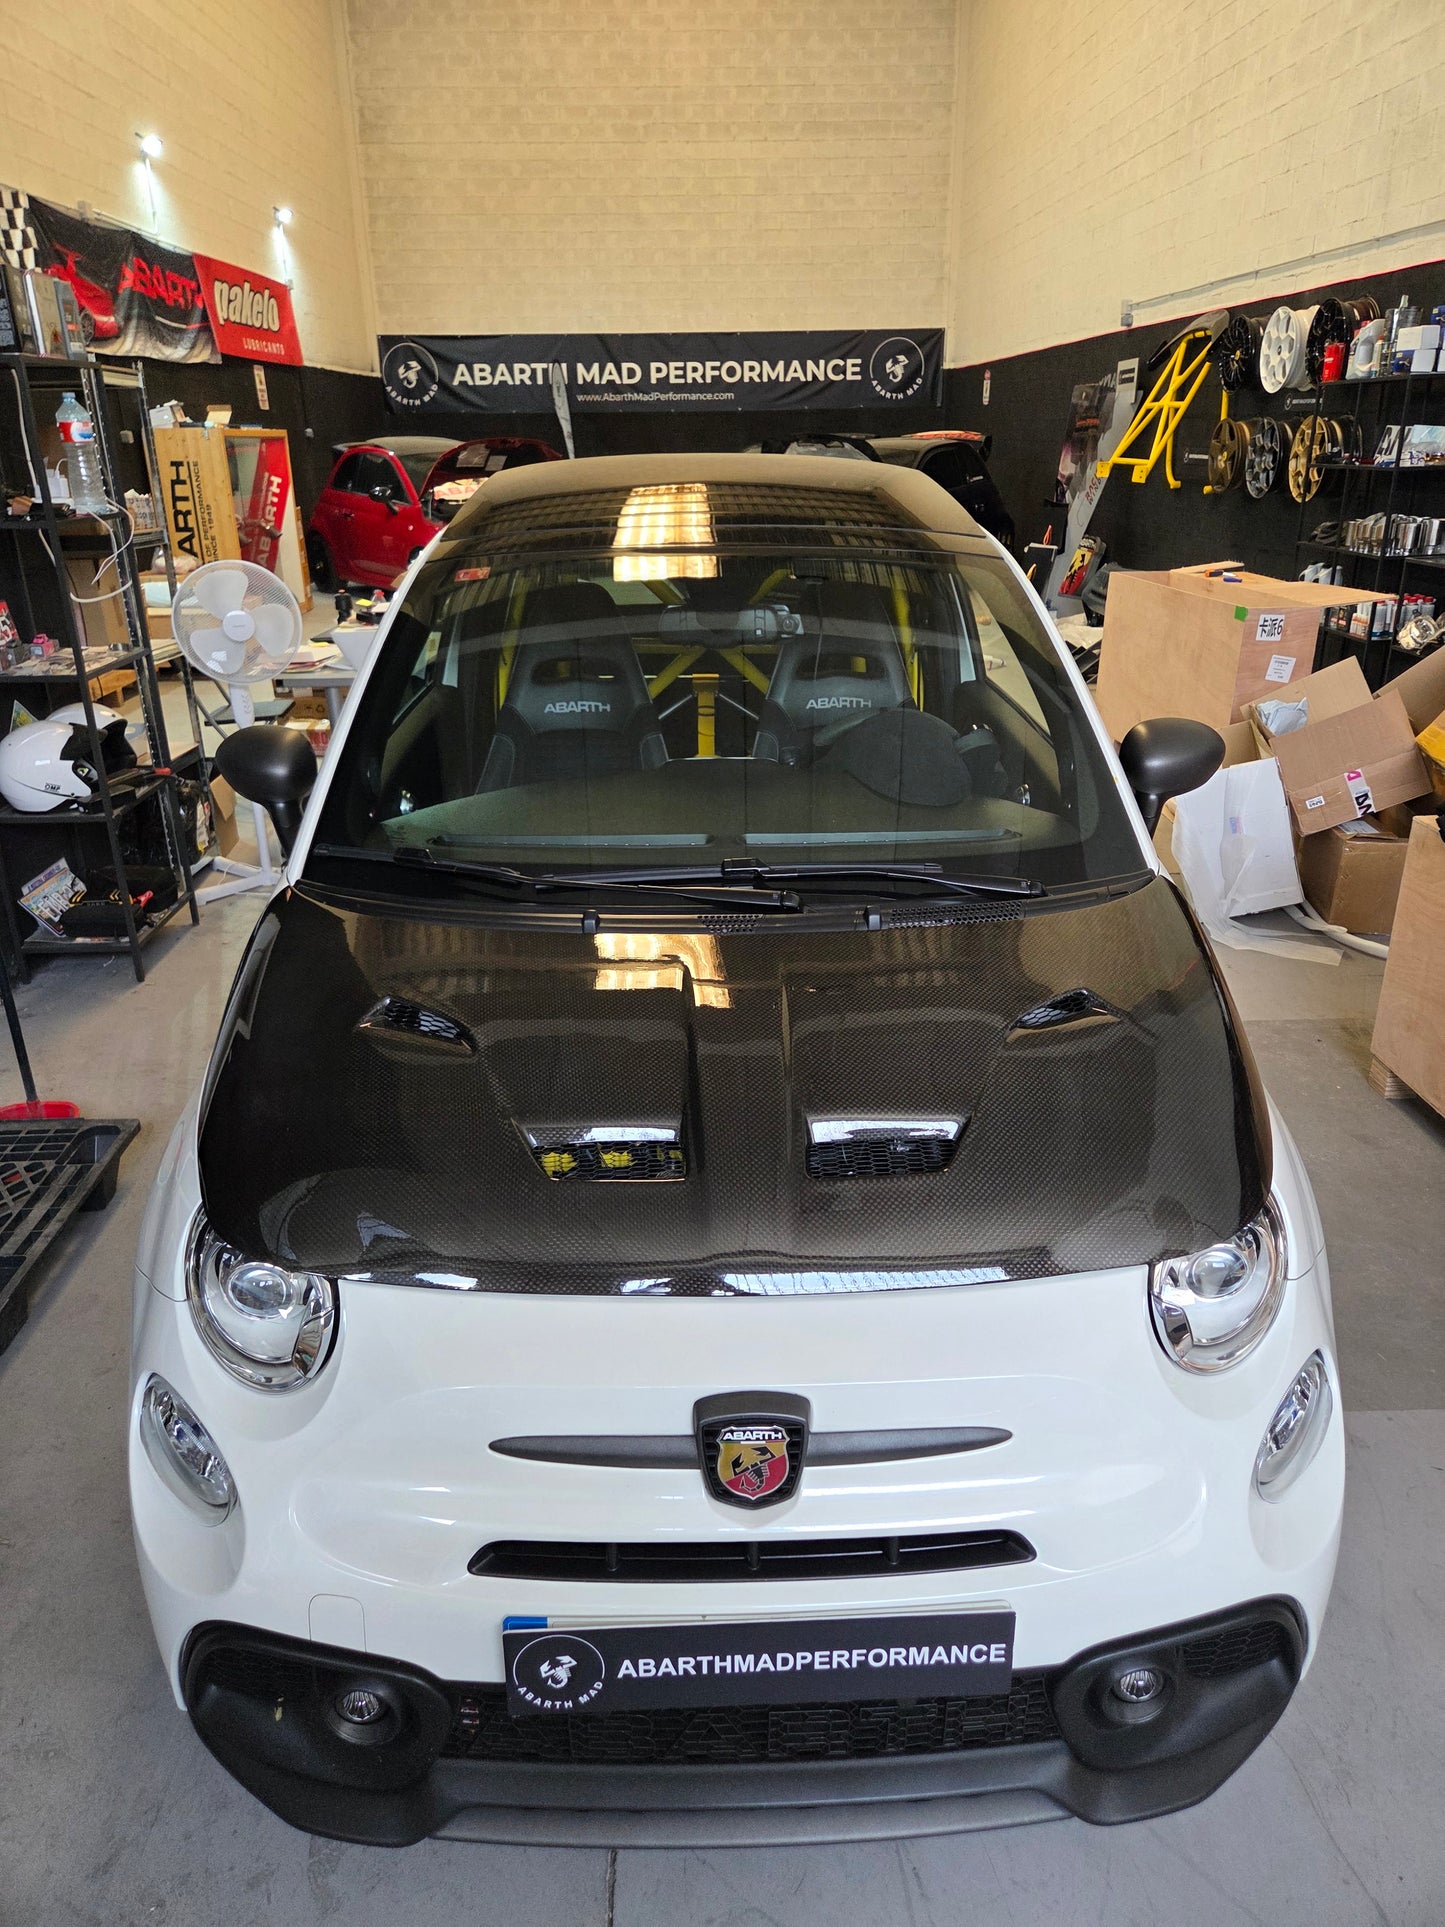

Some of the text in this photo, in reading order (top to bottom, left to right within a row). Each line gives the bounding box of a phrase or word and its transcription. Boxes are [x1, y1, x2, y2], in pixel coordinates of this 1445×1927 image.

[117, 256, 205, 311] ABART
[213, 278, 281, 333] pakelo
[242, 337, 285, 356] LUBRICANTS
[576, 362, 642, 385] MAD
[650, 359, 862, 385] PERFORMANCE
[385, 385, 421, 406] ABARTH
[576, 391, 735, 402] www.AbarthMadPerformance.com
[872, 377, 923, 400] ABARTH MAD
[192, 460, 210, 541] PERFORMANCE
[544, 700, 611, 714] ABARTH
[805, 696, 872, 710] ABARTH
[723, 1430, 782, 1440] ABARTH
[617, 1643, 1007, 1679] ABARTHMADPERFORMANCE
[517, 1681, 603, 1709] ABARTH MAD
